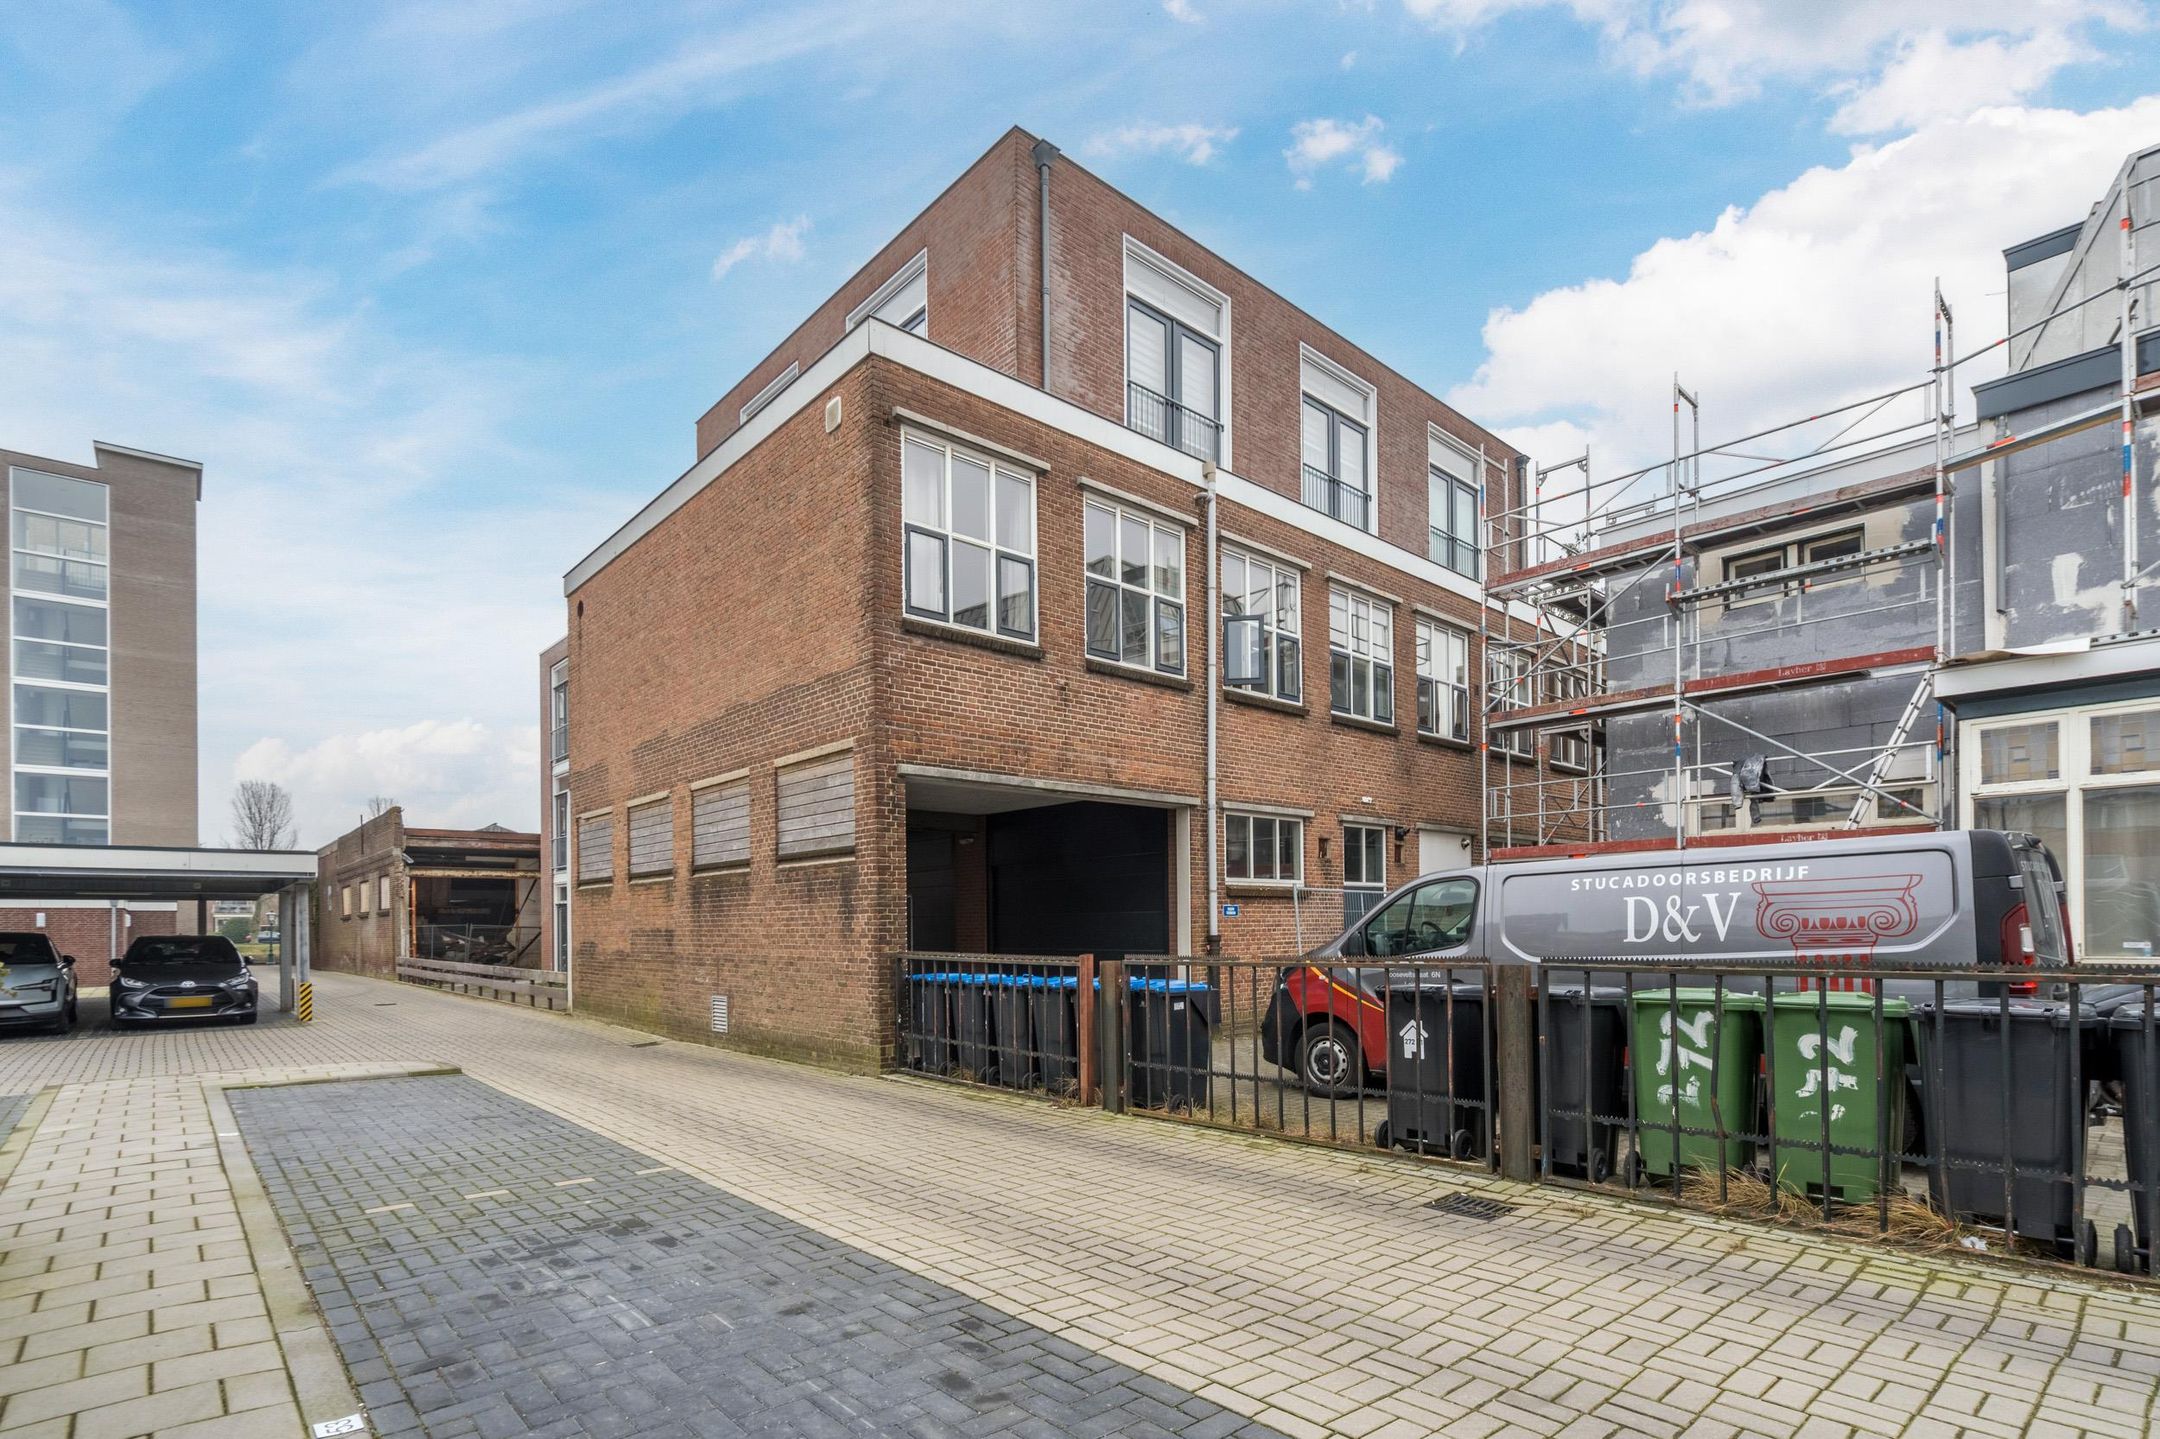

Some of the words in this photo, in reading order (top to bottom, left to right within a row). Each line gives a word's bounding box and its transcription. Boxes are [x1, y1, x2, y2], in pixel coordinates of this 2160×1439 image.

[1570, 865, 1810, 891] STUCADOORSBEDRIJF
[1622, 891, 1742, 943] D&V
[1404, 1038, 1416, 1046] 272
